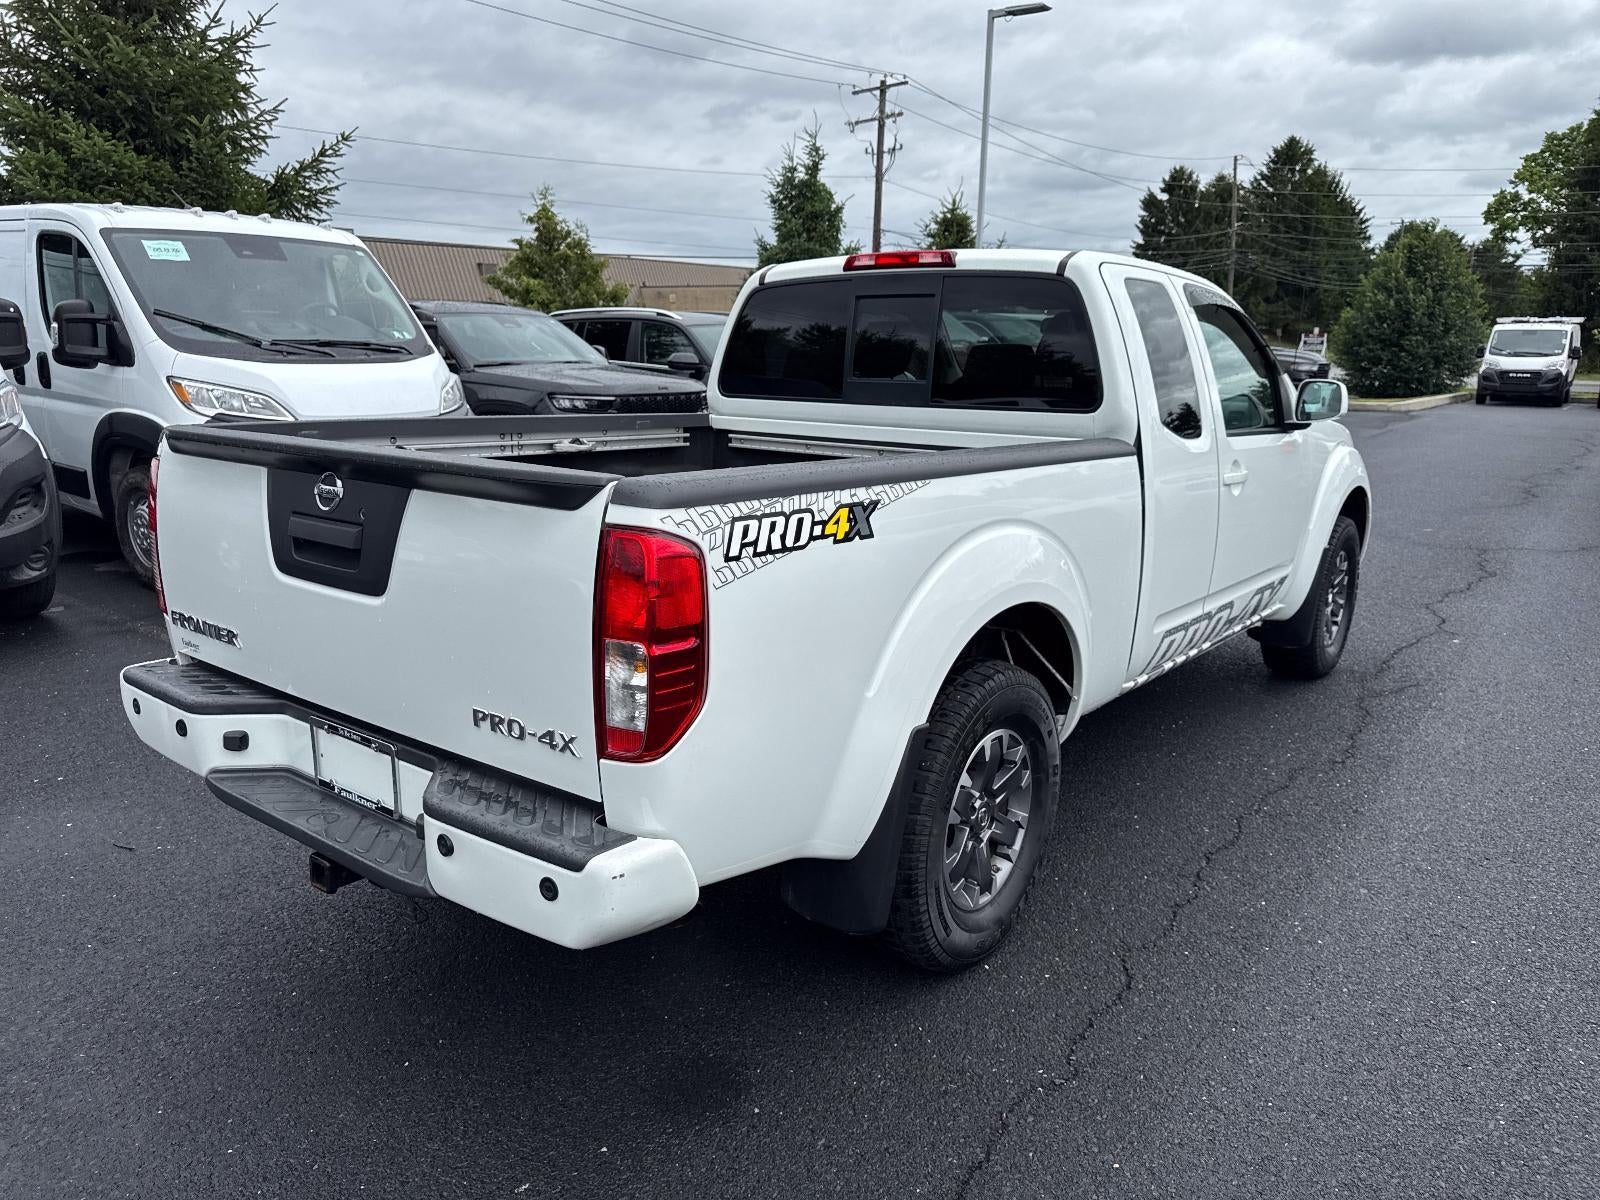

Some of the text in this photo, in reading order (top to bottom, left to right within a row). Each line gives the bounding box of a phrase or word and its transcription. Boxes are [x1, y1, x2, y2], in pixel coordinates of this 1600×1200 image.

[724, 499, 881, 562] PRO-4X
[171, 610, 243, 649] FRONTIER
[472, 705, 582, 759] PRO-4X
[334, 786, 377, 809] Faulkner
